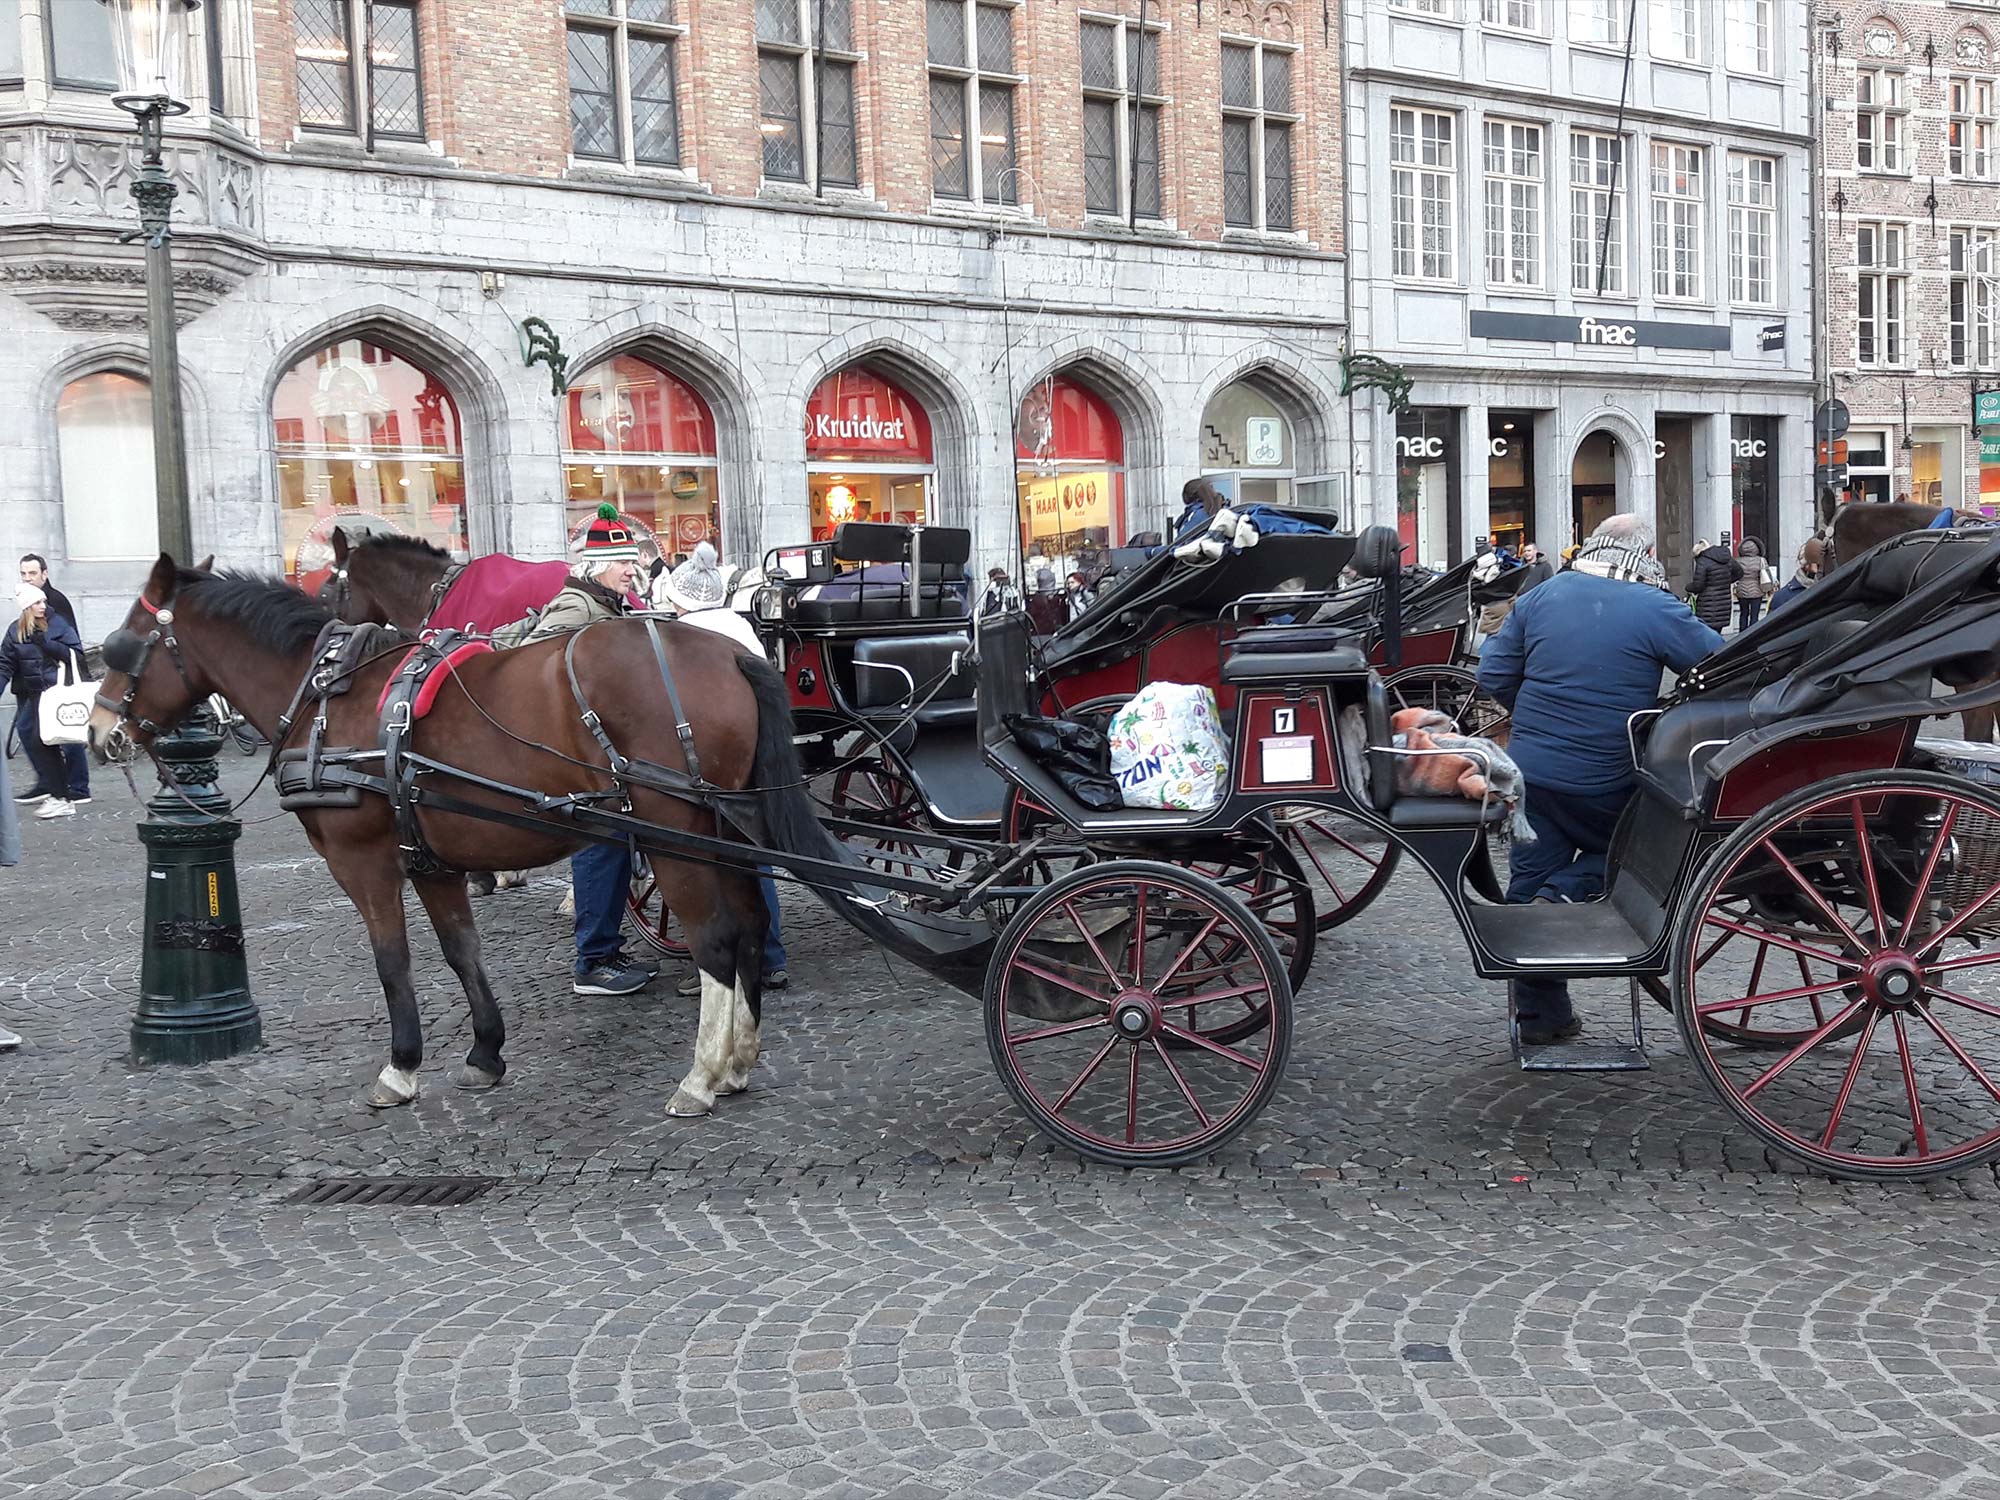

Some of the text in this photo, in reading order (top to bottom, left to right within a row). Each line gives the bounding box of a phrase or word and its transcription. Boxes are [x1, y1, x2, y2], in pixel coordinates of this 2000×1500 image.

[1579, 316, 1637, 345] fnac
[1762, 331, 1784, 341] fnac
[816, 414, 905, 439] Kruidvat
[1260, 422, 1271, 441] P
[1395, 436, 1443, 457] nac
[1730, 439, 1766, 458] nac
[1035, 496, 1058, 516] HAAR
[1278, 712, 1290, 730] 7
[209, 873, 218, 916] 2229
